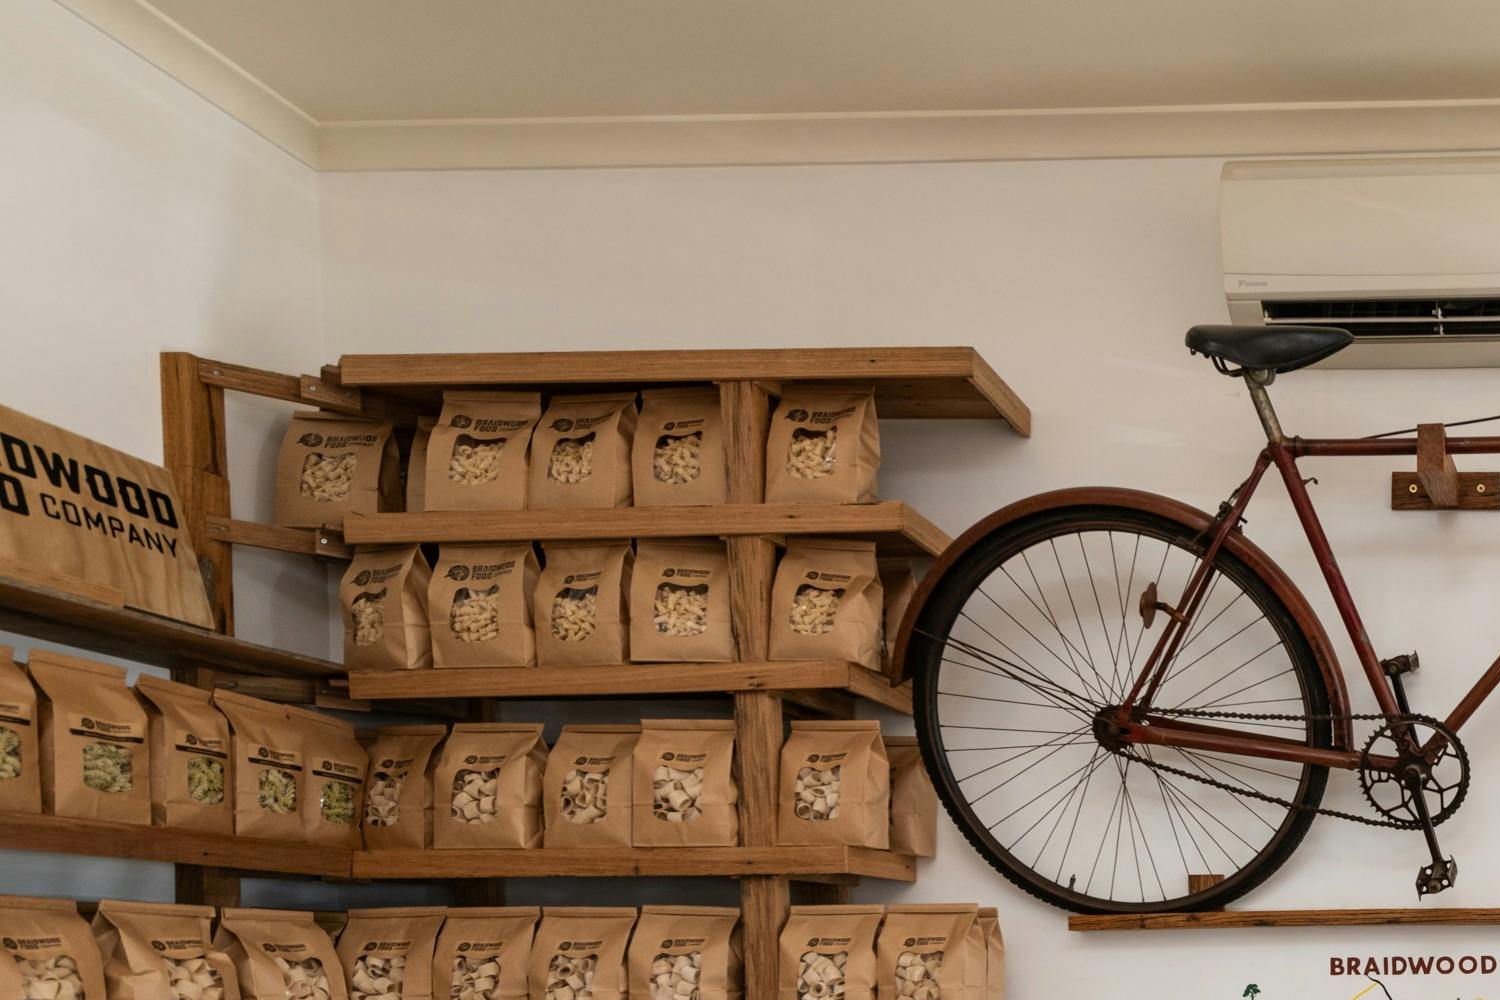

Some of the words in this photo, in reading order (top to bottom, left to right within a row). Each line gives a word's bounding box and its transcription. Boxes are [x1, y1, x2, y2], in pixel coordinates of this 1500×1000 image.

[0, 432, 179, 529] DWOOD
[40, 492, 177, 558] COMPANY
[1330, 955, 1497, 976] BRAIDWOOD
